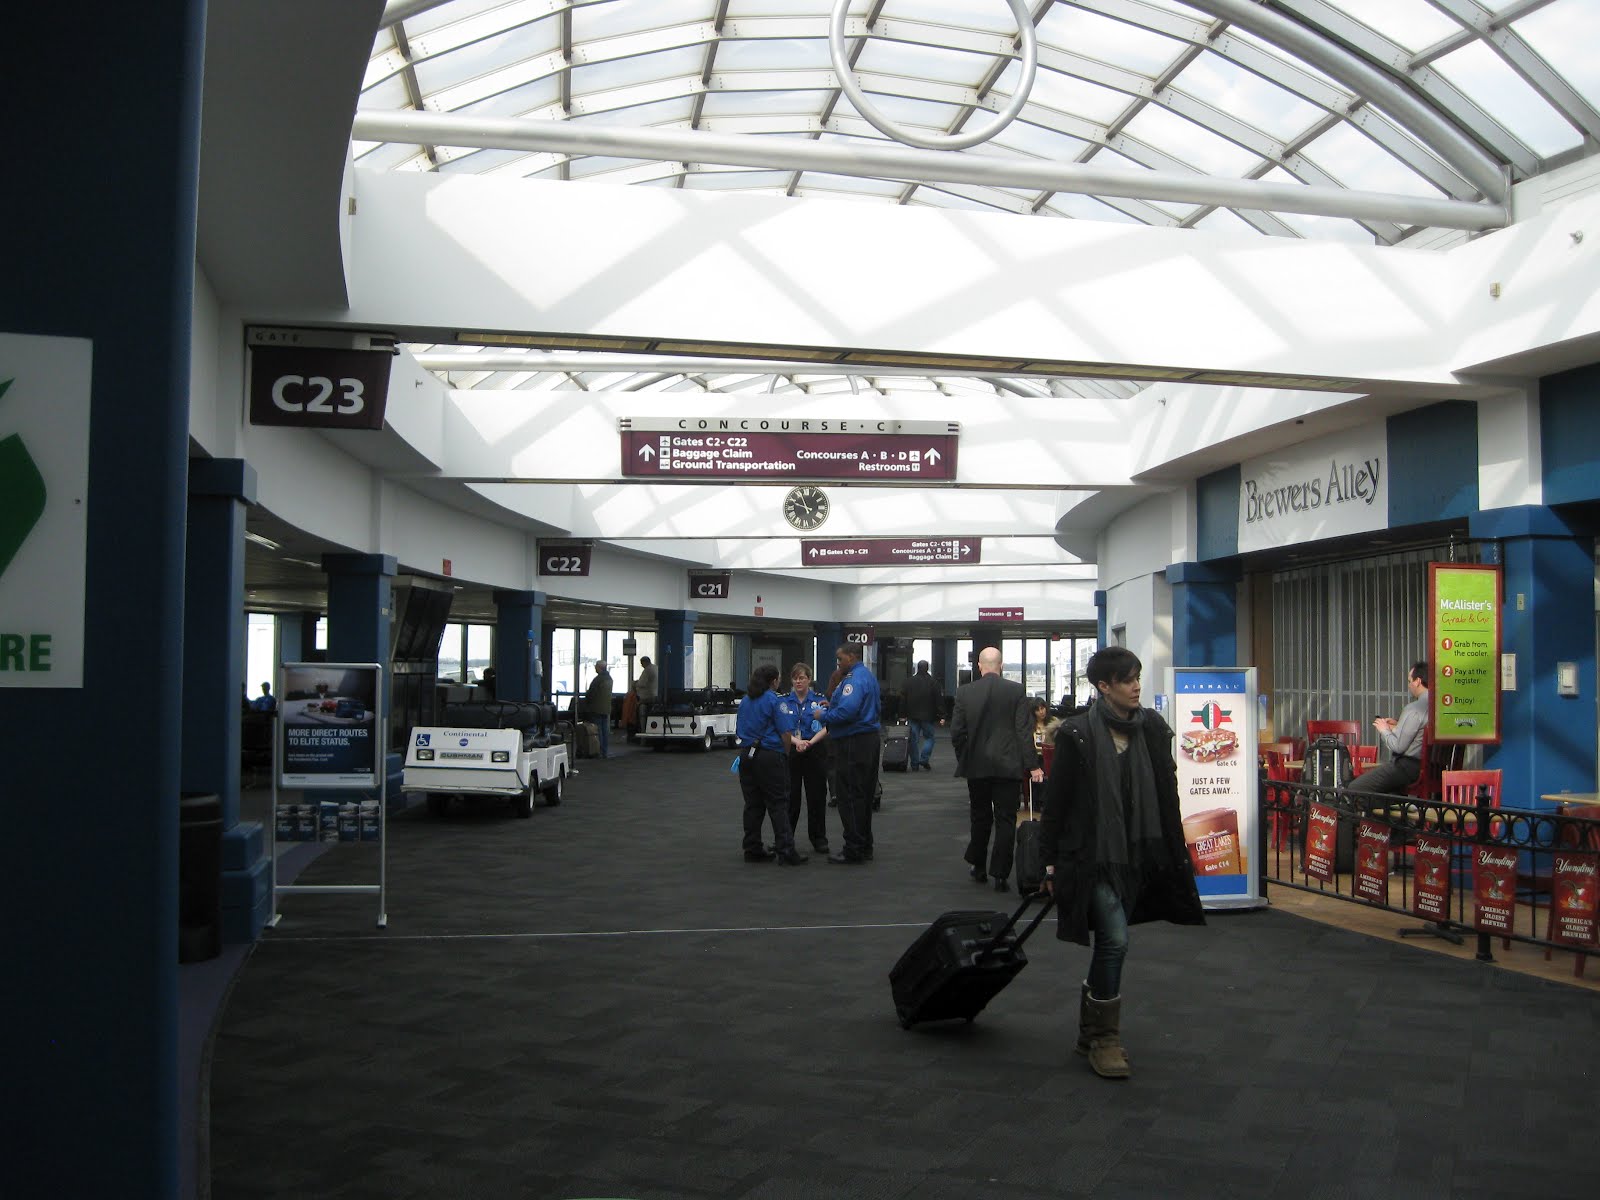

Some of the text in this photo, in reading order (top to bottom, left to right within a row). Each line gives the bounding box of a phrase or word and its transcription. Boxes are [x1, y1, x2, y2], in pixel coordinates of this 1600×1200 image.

[271, 374, 365, 414] C23
[678, 419, 885, 431] CONCOURSE C
[673, 437, 703, 447] Gates
[727, 438, 747, 447] C22
[673, 449, 752, 459] Baggage Claim
[797, 450, 907, 460] Concourses A B D
[673, 460, 796, 471] Ground Transportation
[859, 462, 910, 472] Restrooms
[1245, 457, 1380, 524] Brewers Alley
[546, 556, 581, 572] C22
[698, 583, 722, 596] C21
[1440, 599, 1492, 611] McAlister's
[1441, 612, 1489, 625] Grab & Go
[847, 633, 868, 643] C20
[1444, 640, 1450, 649] 1
[1454, 649, 1465, 657] the
[1444, 667, 1451, 676] 2
[1454, 668, 1467, 676] Pay
[1444, 696, 1475, 705] 3 Enjoy!
[288, 728, 368, 737] MORE DIRECT ROUTES
[443, 730, 488, 738] Continental
[289, 737, 350, 746] TO ELITE STATUS.
[1192, 777, 1231, 785] JUST A FEW
[1189, 787, 1210, 795] GATES
[1310, 807, 1337, 826] Yuengling
[1360, 824, 1389, 843] Yuengling
[1195, 838, 1213, 852] GREAT
[1213, 835, 1232, 848] LAKES
[1416, 839, 1449, 857] Yuengling
[1478, 850, 1516, 869] Yuengling
[1555, 857, 1595, 875] Yuengling
